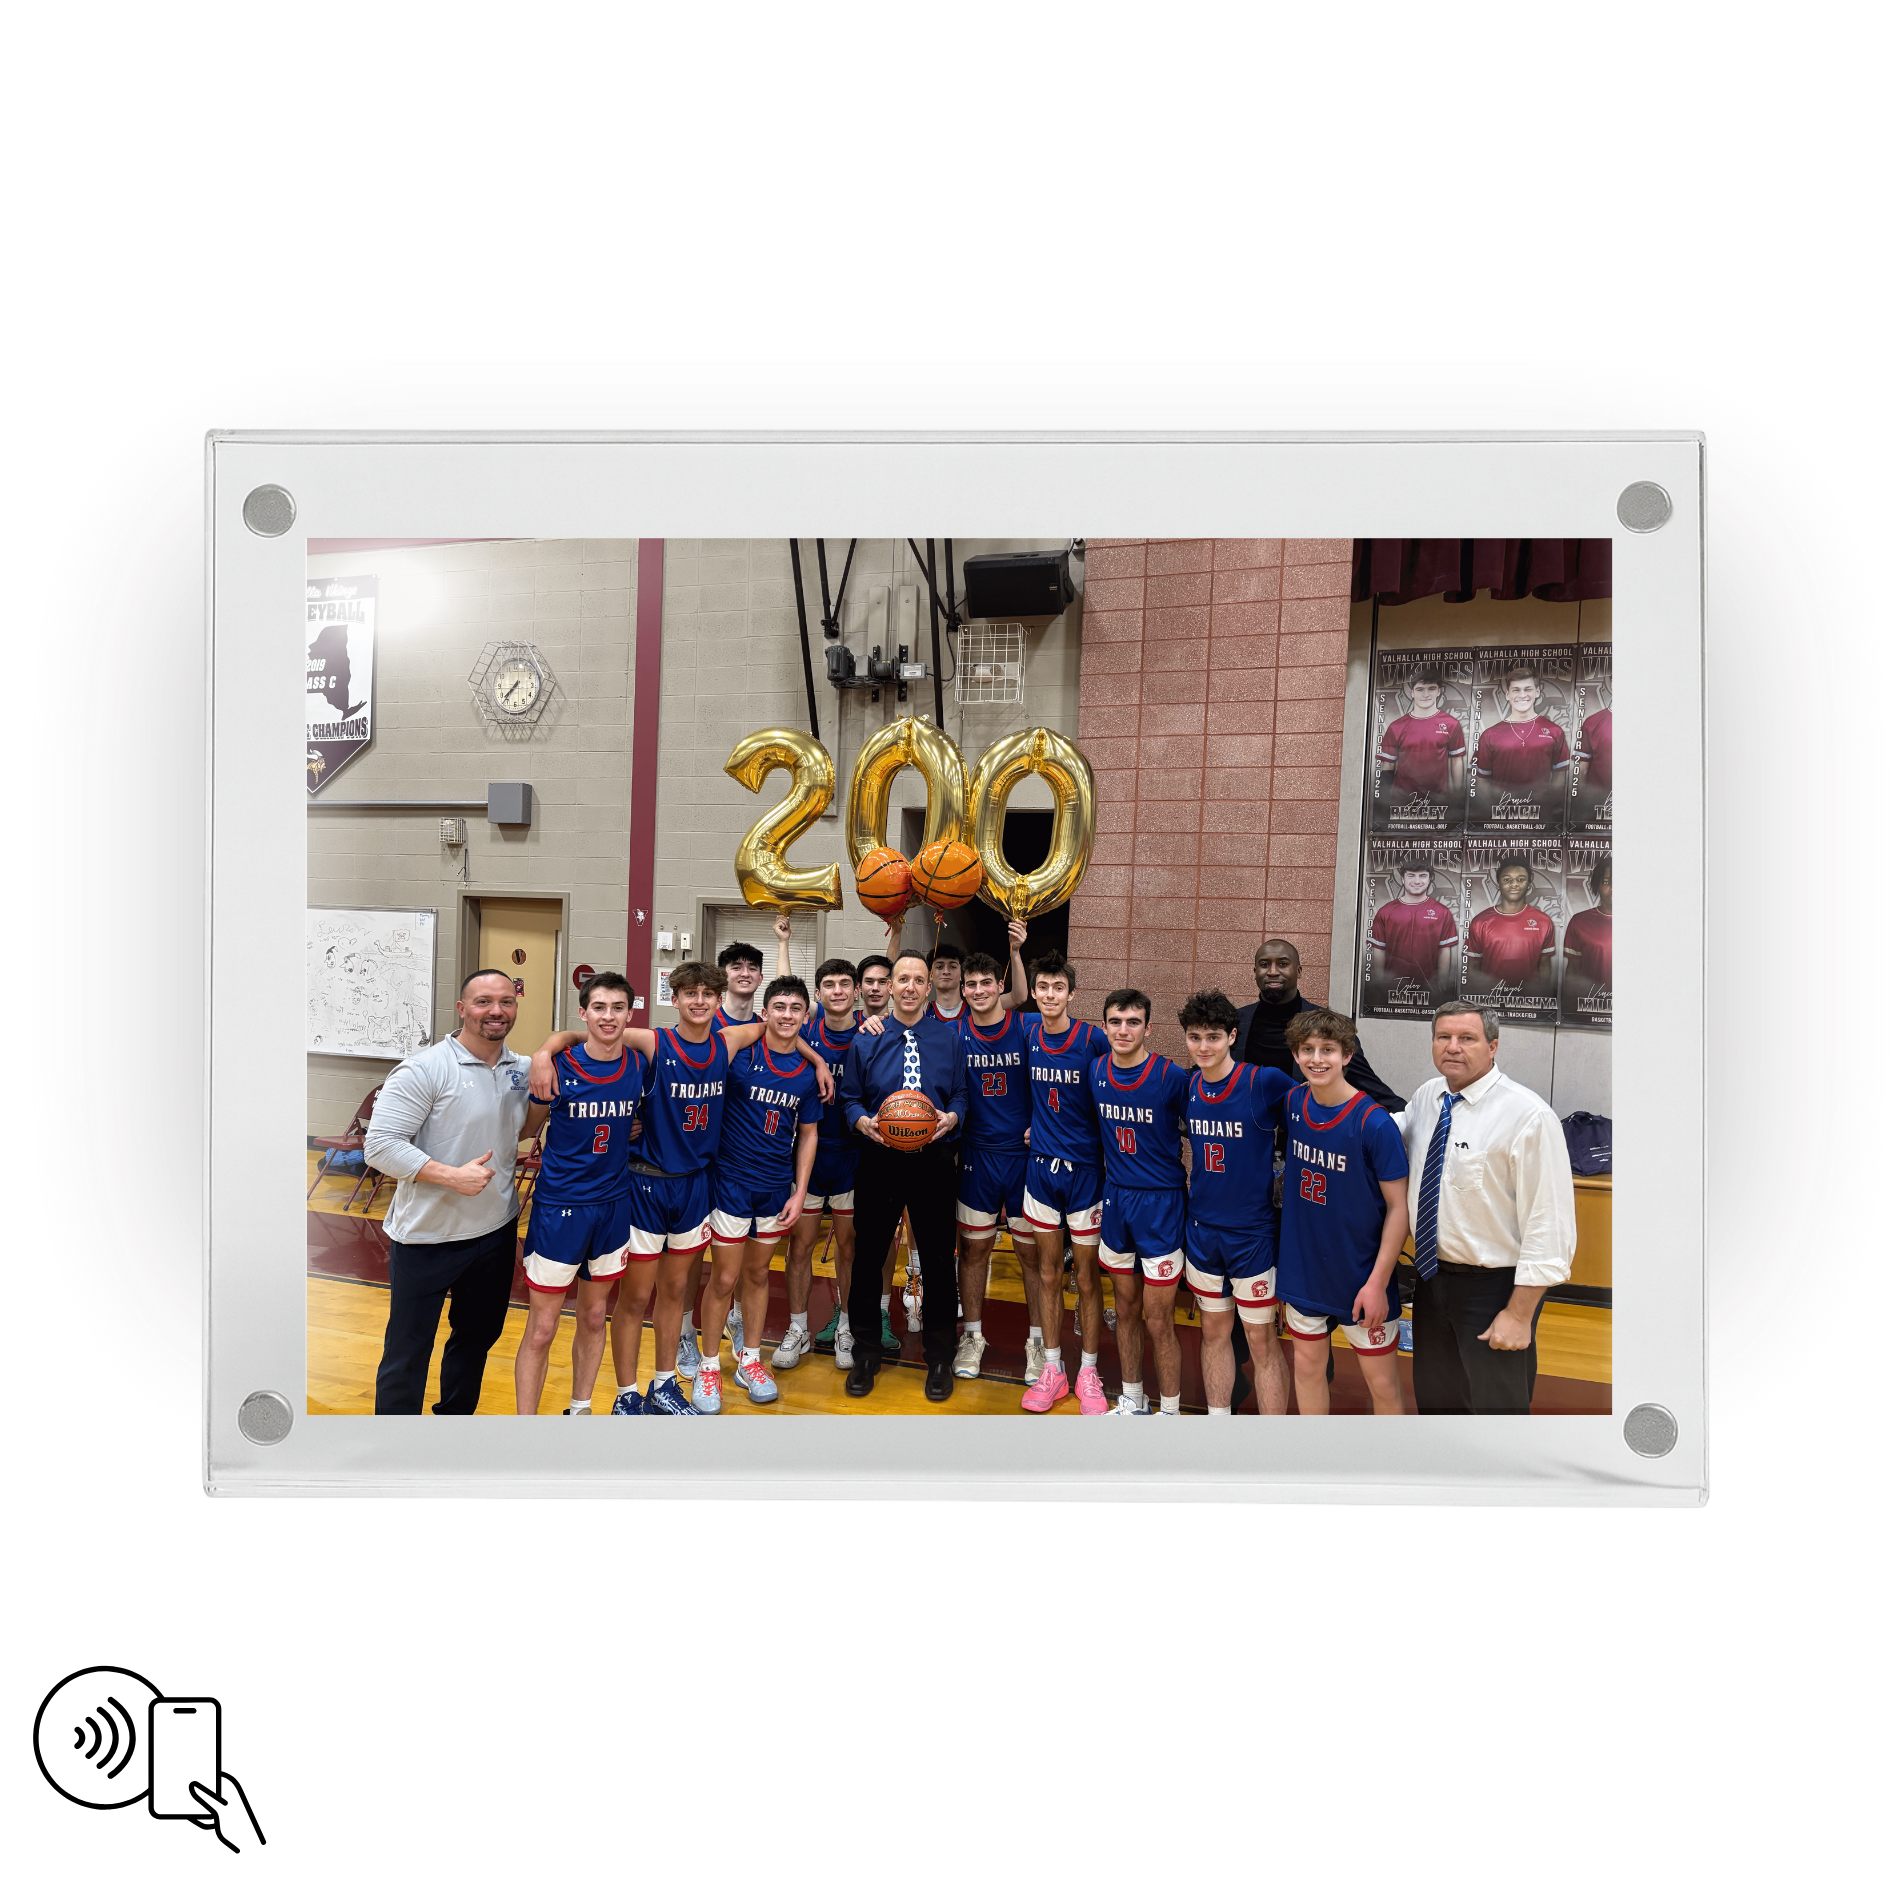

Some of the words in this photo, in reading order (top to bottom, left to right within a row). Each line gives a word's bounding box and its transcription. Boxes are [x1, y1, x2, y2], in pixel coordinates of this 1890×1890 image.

[1382, 653, 1421, 663] VALHALLA
[1423, 652, 1441, 661] HIGH
[1444, 651, 1473, 660] SCHOOL
[1479, 649, 1518, 659] VALHALLA
[1521, 649, 1540, 658] HIGH
[1542, 648, 1573, 657] SCHOOL
[307, 658, 326, 672] 2019
[328, 675, 337, 689] C
[312, 716, 369, 740] CHAMPIONS
[723, 714, 1097, 921] 200
[1491, 805, 1541, 820] LYNCH
[1372, 840, 1410, 849] VALHALLA
[1412, 840, 1431, 848] HIGH
[1433, 840, 1462, 848] SCHOOL
[1468, 839, 1508, 848] VALHALLA
[1510, 839, 1529, 847] HIGH
[1532, 839, 1562, 847] SCHOOL
[1569, 840, 1610, 849] VALHALLA
[1387, 990, 1430, 1005] RATTI
[966, 1052, 1020, 1068] TROJANS
[981, 1072, 1007, 1097] 23
[1031, 1066, 1080, 1084] TROJANS
[670, 1080, 723, 1099] TROJANS
[749, 1085, 801, 1110] TROJANS
[568, 1100, 634, 1119] TROJANS
[1048, 1088, 1060, 1113] 4
[682, 1104, 709, 1132] 34
[764, 1109, 779, 1135] 11
[1099, 1102, 1153, 1124] TROJANS
[888, 1124, 929, 1137] Wilson
[1189, 1118, 1243, 1138] TROJANS
[593, 1124, 611, 1154] 2
[1115, 1126, 1137, 1155] 10
[1204, 1142, 1225, 1173] 12
[1292, 1139, 1347, 1172] TROJANS
[1299, 1168, 1326, 1205] 22
